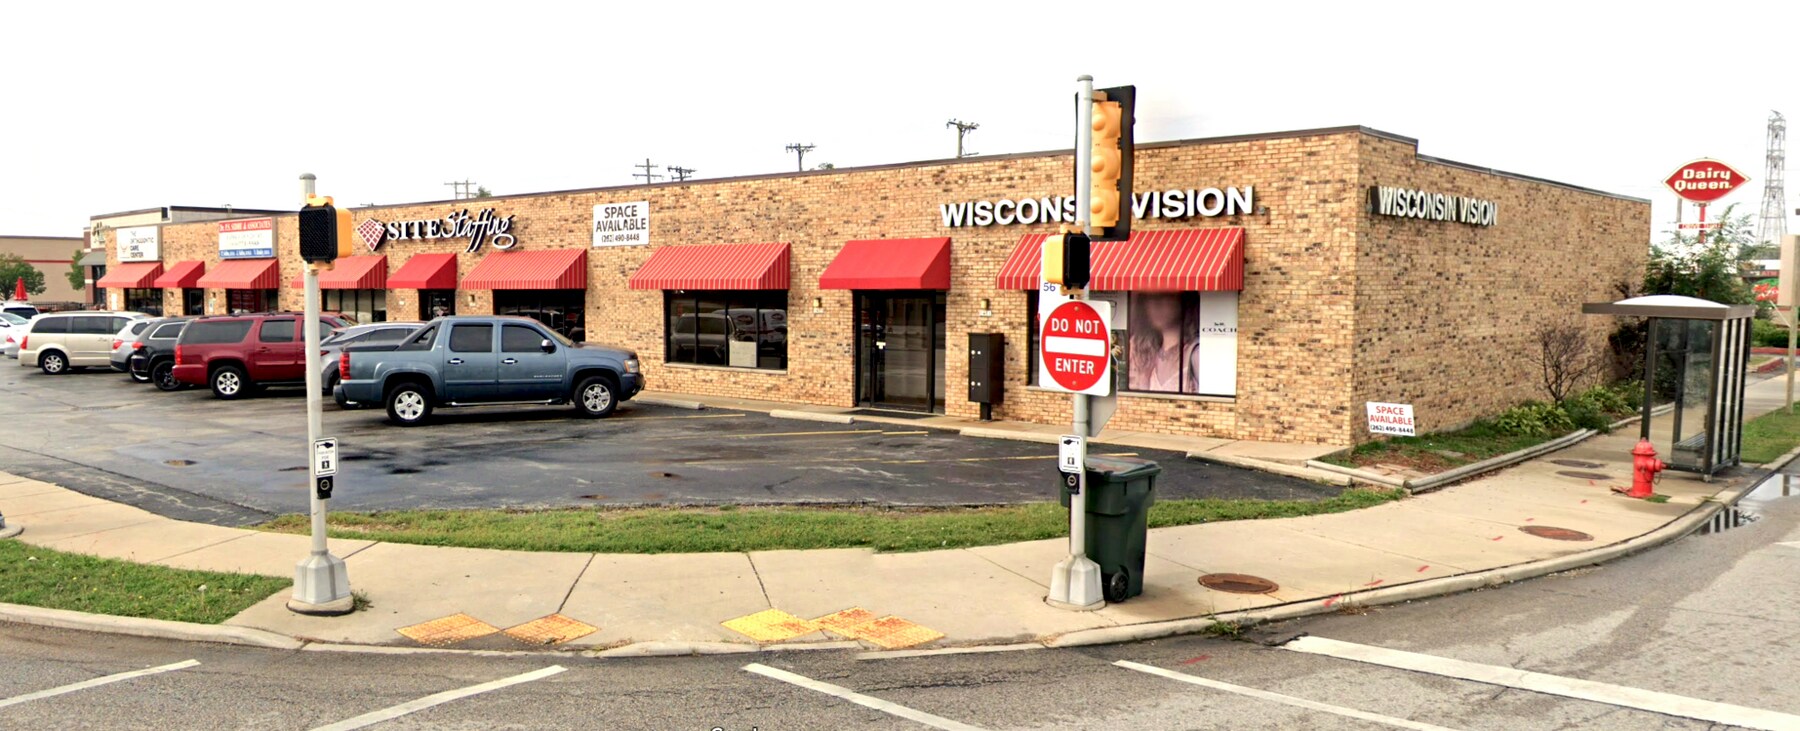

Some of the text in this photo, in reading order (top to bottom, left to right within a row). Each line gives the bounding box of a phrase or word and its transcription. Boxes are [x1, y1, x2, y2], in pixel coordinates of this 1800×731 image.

[1682, 167, 1731, 180] Dairy
[604, 204, 638, 219] SPACE
[939, 186, 1254, 227] WISCONS VISION
[1379, 186, 1497, 225] WISCONSIN VISION
[386, 207, 515, 253] SITE Staffing
[595, 217, 647, 233] AVAILABLE
[614, 232, 640, 242] 490-8448
[1043, 282, 1056, 292] 56
[1051, 317, 1100, 335] DO NOT
[1055, 357, 1095, 375] ENTER
[1376, 406, 1404, 415] SPACE
[1370, 415, 1412, 425] AVAILABLE
